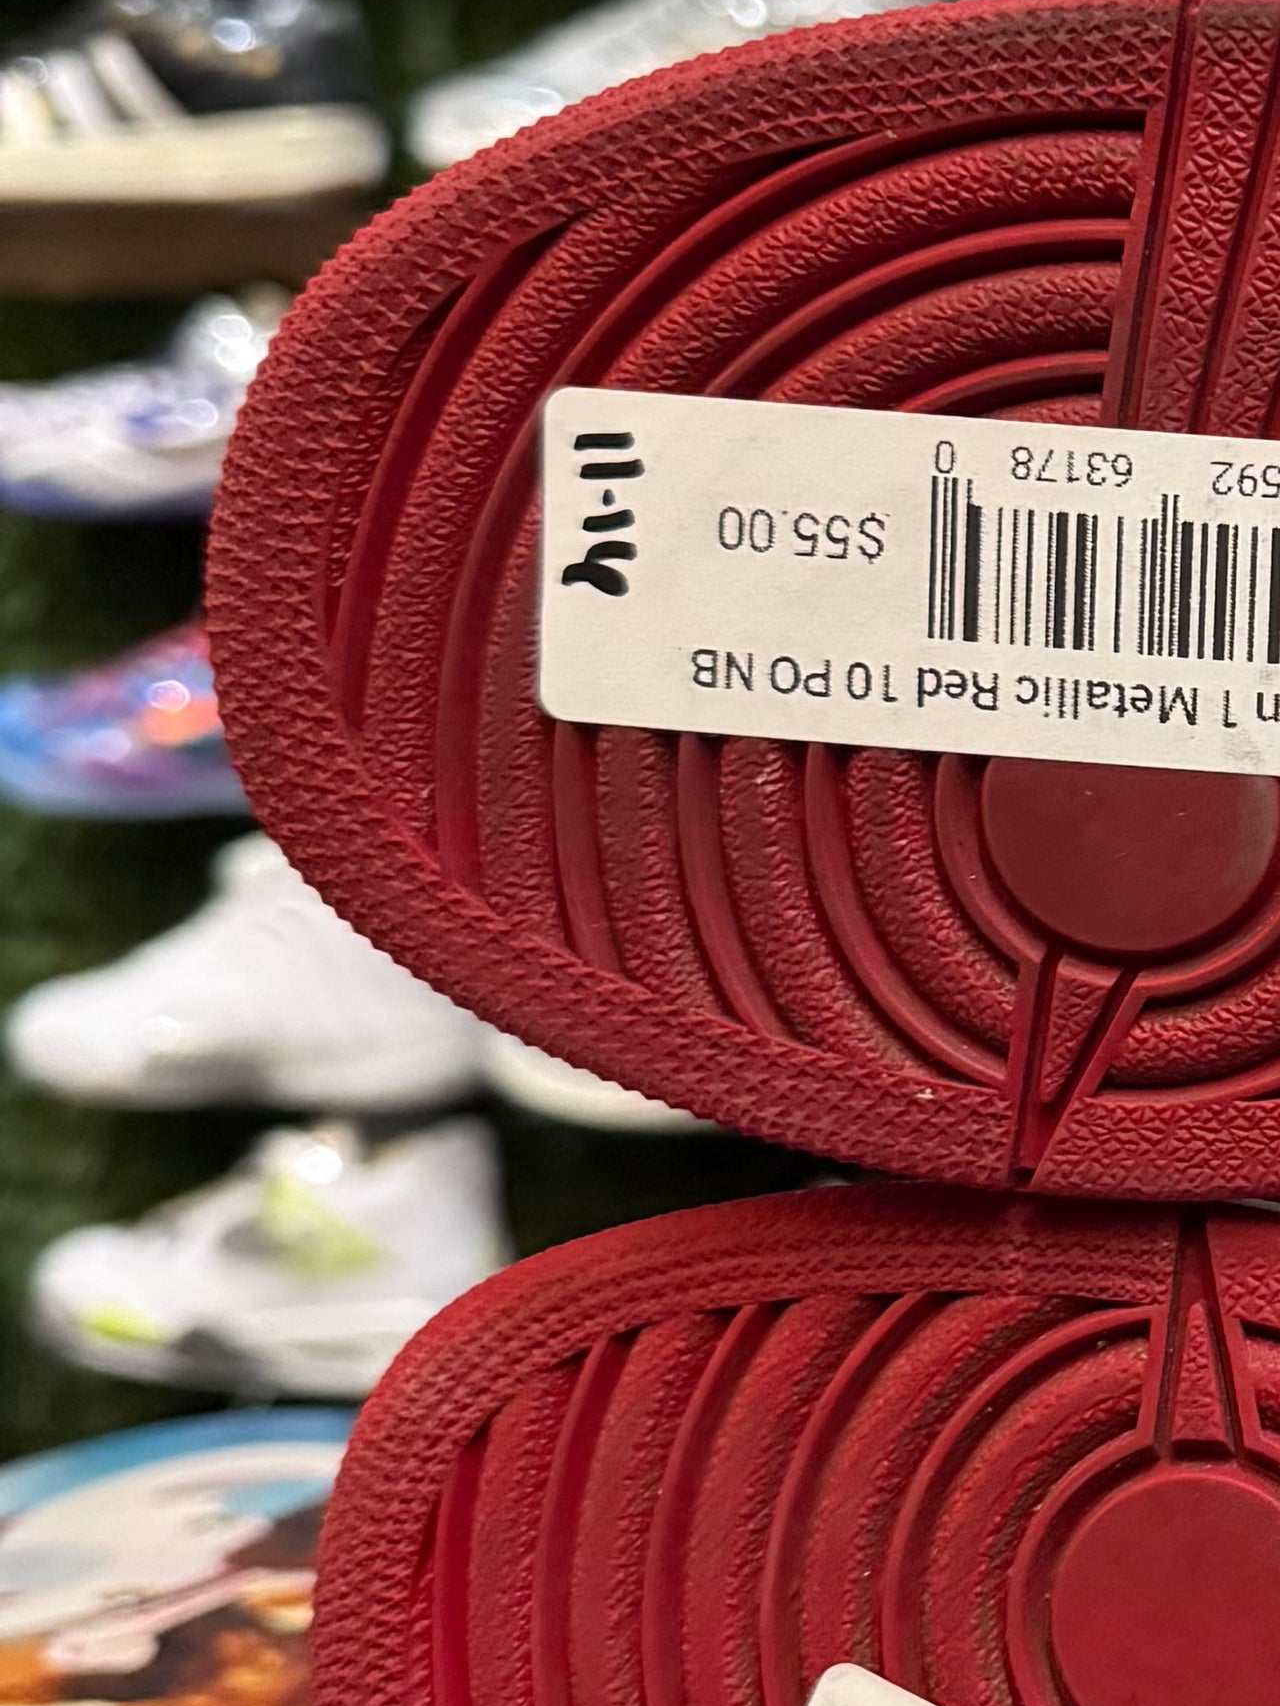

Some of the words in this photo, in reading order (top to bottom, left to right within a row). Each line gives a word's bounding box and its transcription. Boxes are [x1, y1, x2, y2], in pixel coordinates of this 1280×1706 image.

[934, 440, 956, 474] 0
[1011, 446, 1133, 488] 63178
[717, 506, 887, 564] $55.00
[691, 648, 754, 692] NB
[769, 656, 831, 698] PO
[846, 661, 898, 703] 10
[916, 667, 999, 712] Red
[1015, 675, 1199, 727] Metallic
[1222, 688, 1238, 729] 1
